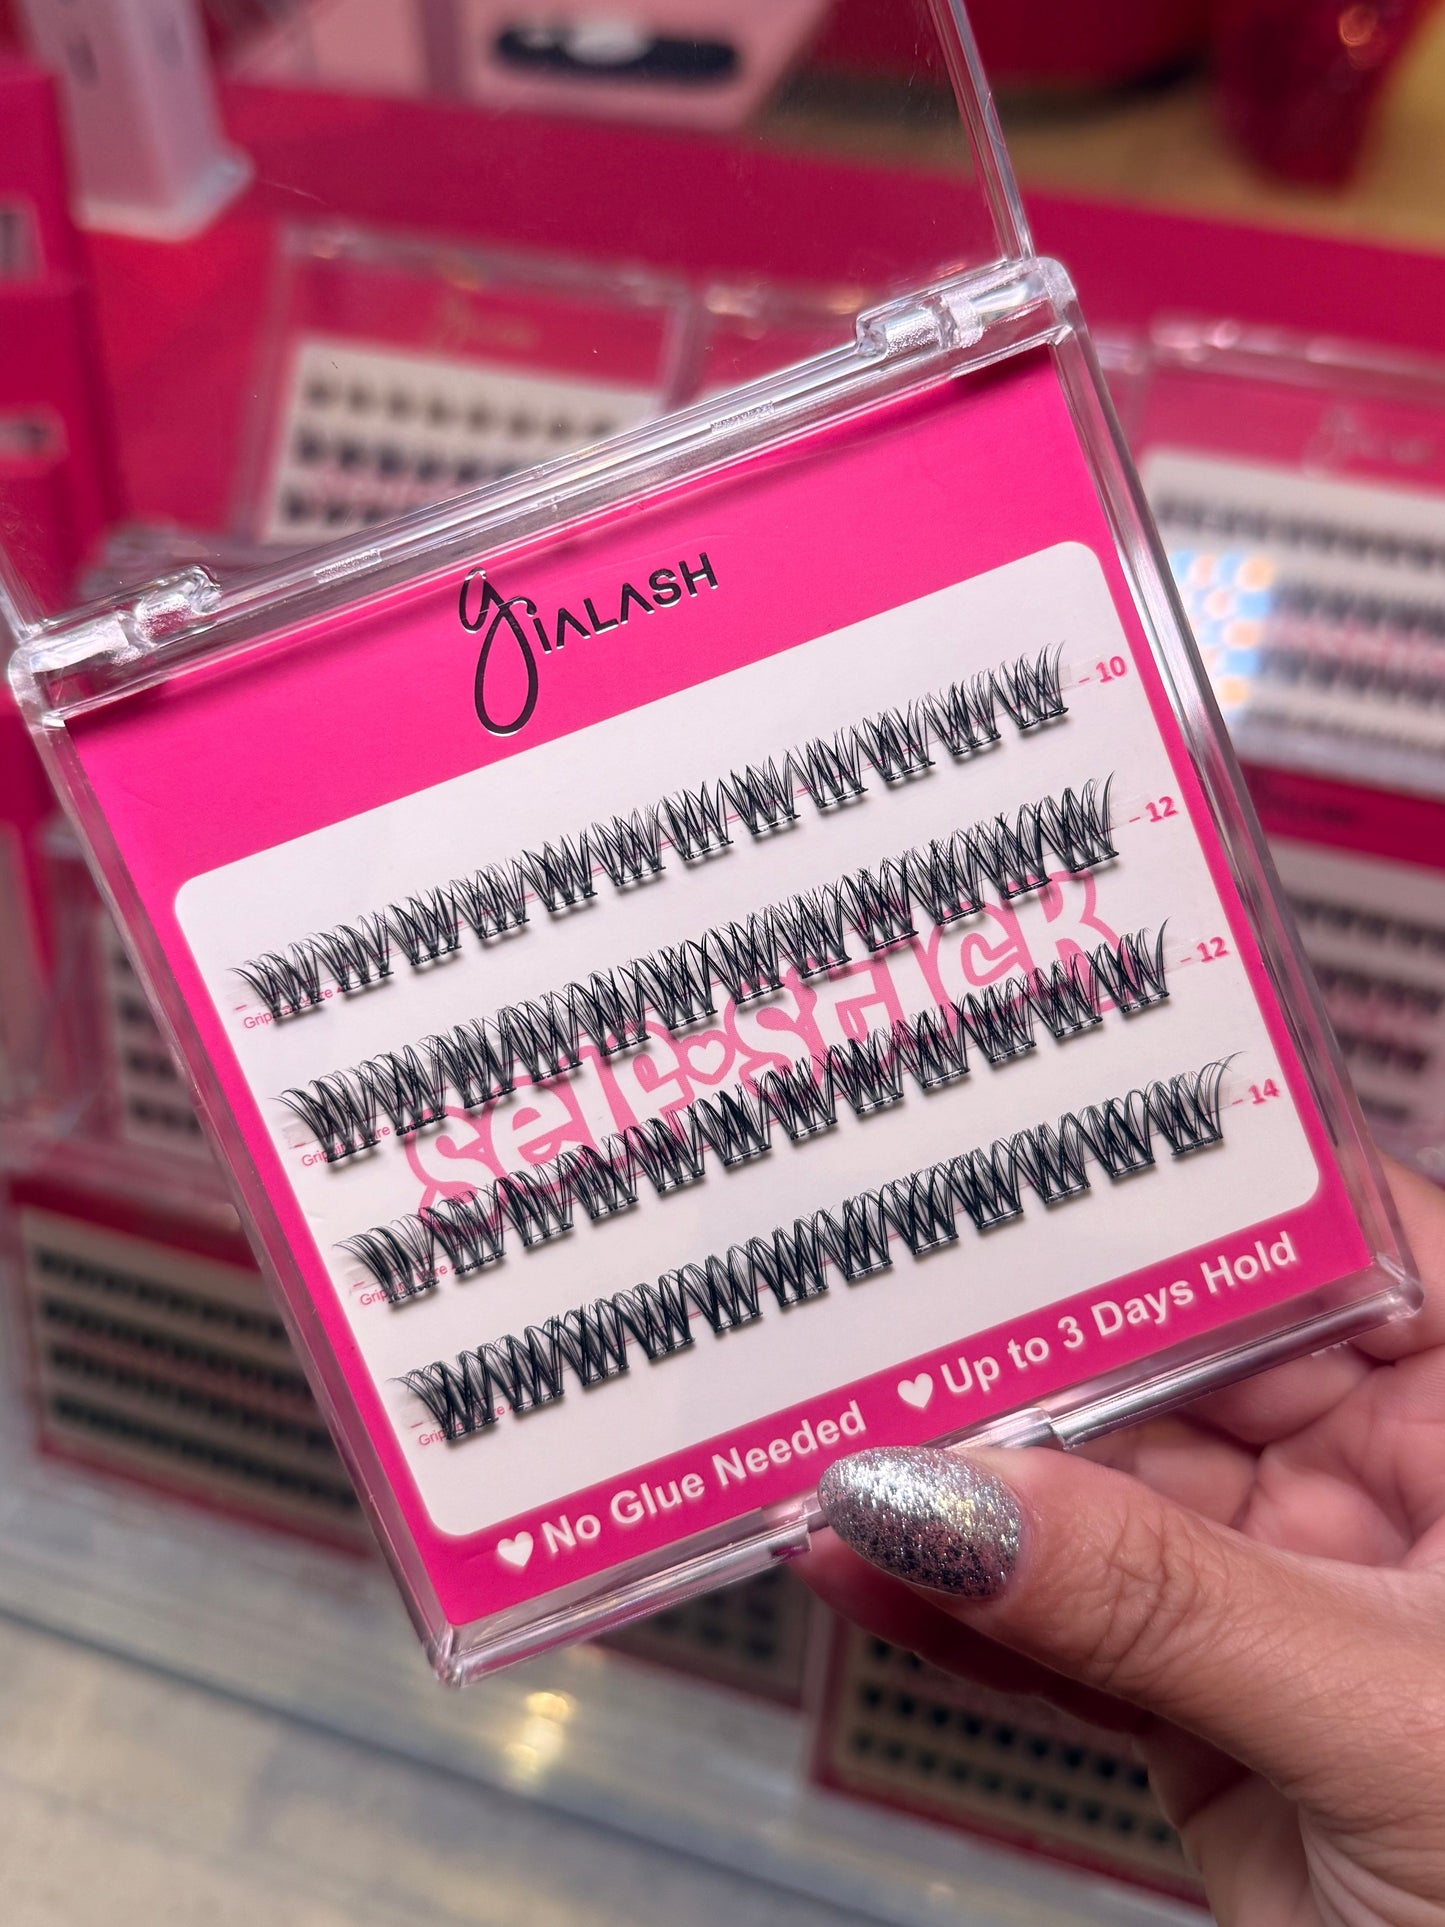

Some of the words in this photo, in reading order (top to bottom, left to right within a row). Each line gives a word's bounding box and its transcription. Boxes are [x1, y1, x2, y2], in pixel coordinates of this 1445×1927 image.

[1095, 656, 1126, 683] 10
[1145, 796, 1179, 823] 12
[1197, 936, 1230, 963] 12
[1248, 1078, 1280, 1105] 14
[940, 1356, 1000, 1394] Up
[1007, 1337, 1050, 1370] to
[1057, 1316, 1084, 1349] 3
[1091, 1279, 1194, 1338] Days
[1200, 1230, 1298, 1294] Hold
[541, 1514, 601, 1553] No
[610, 1472, 705, 1525] Glue
[711, 1400, 867, 1487] Needed
